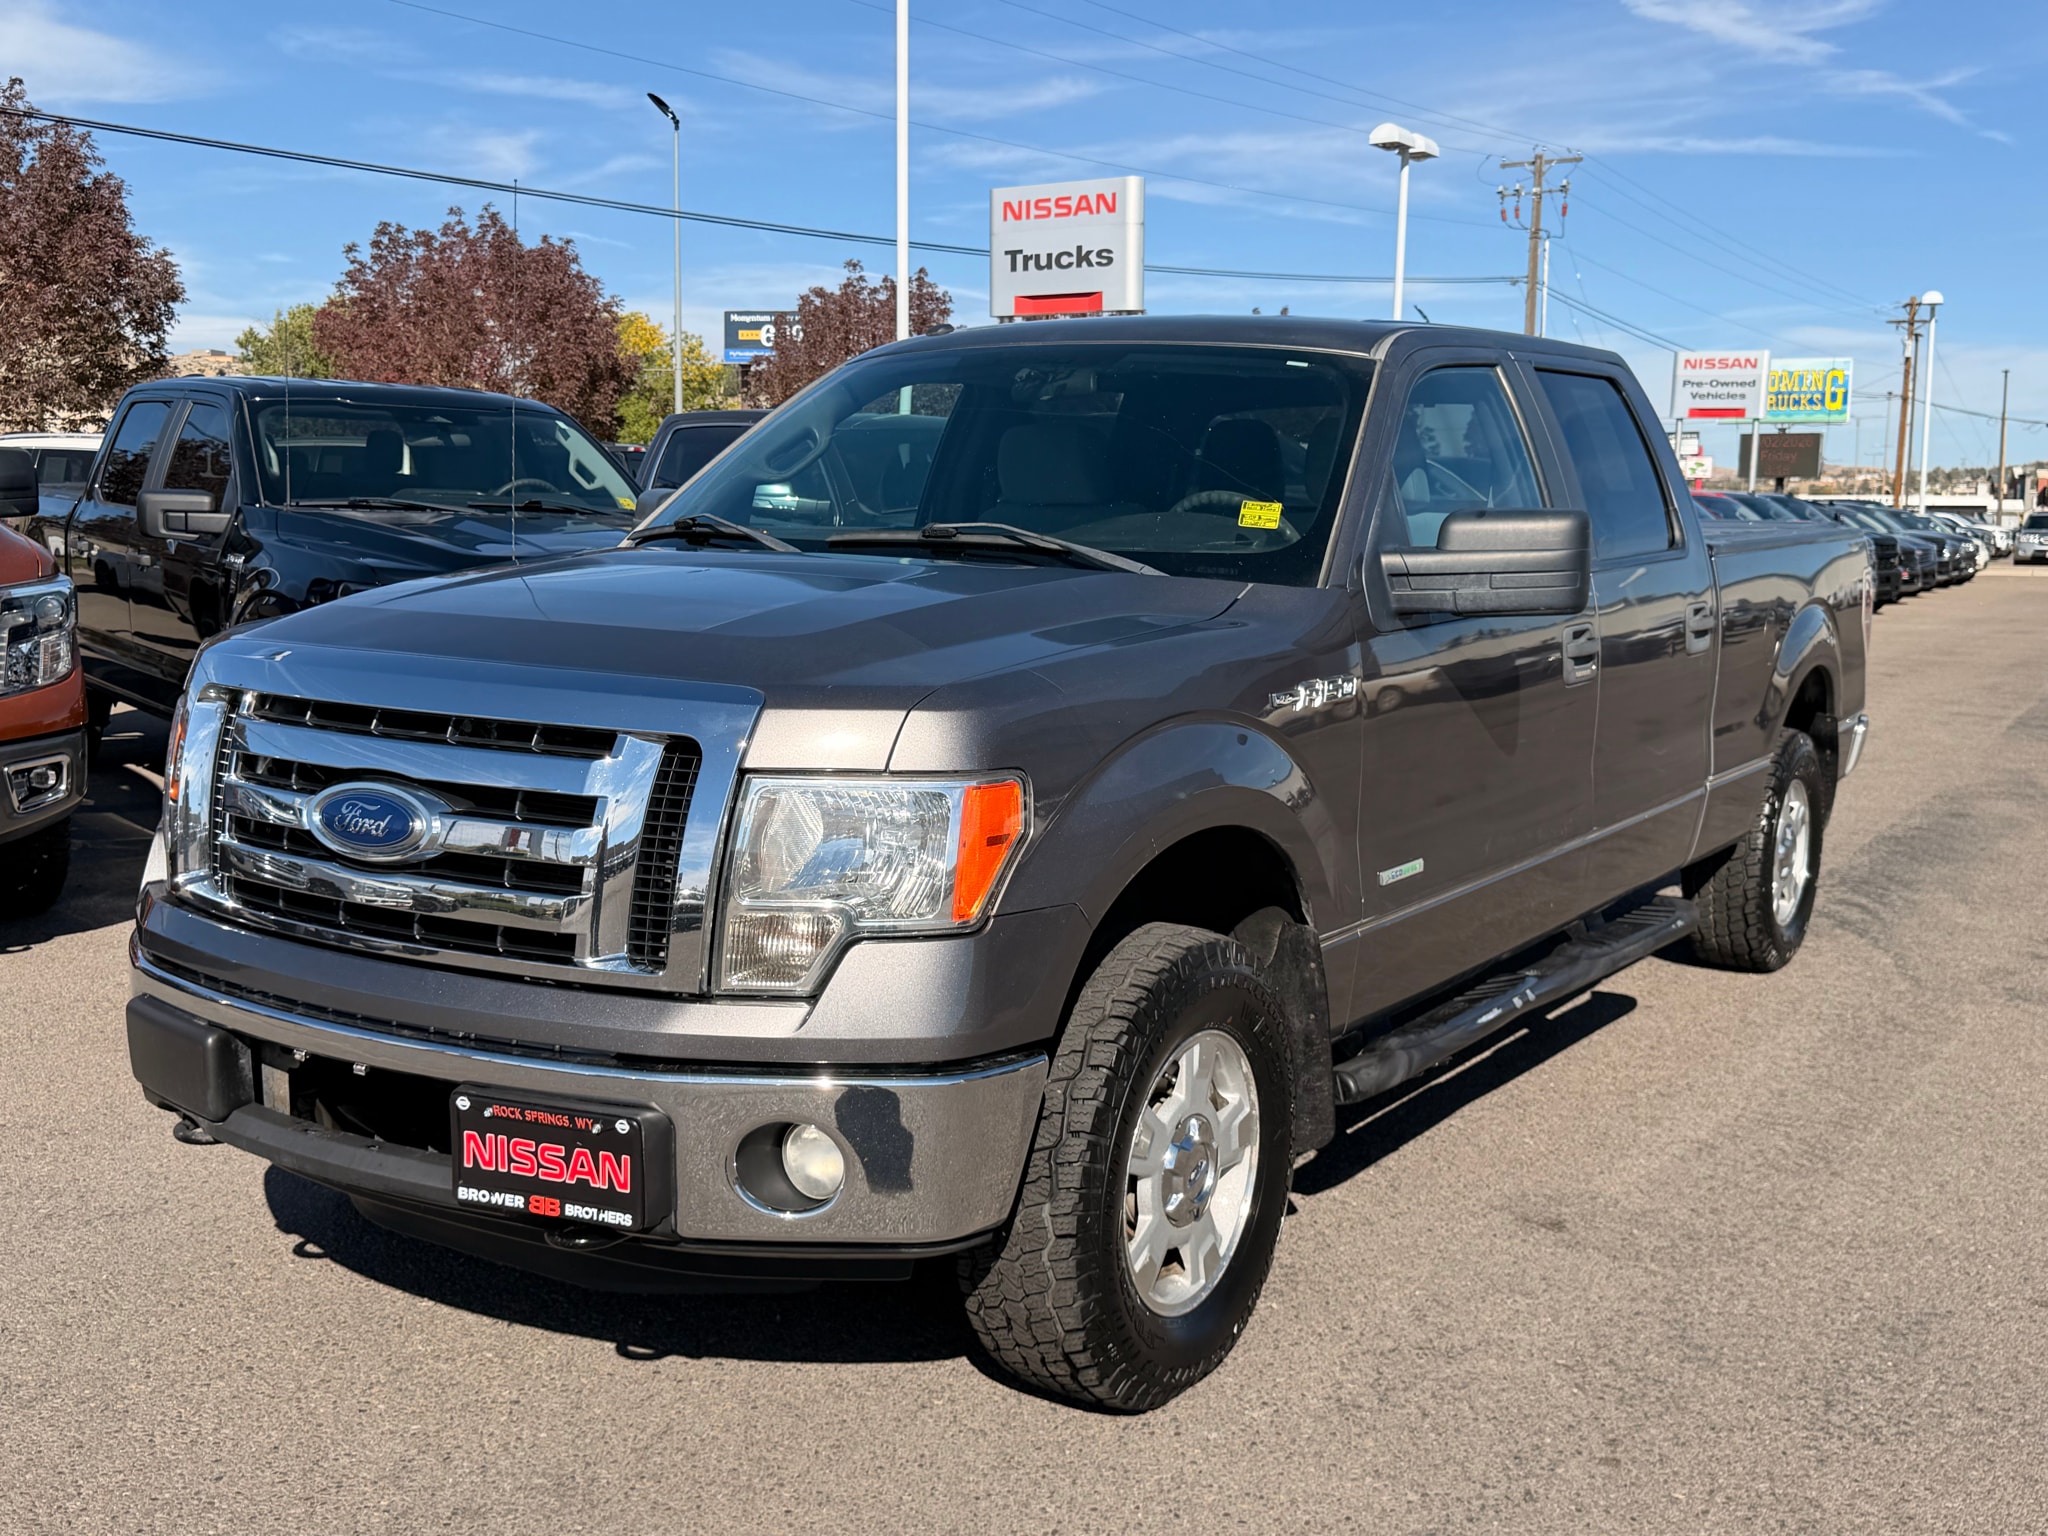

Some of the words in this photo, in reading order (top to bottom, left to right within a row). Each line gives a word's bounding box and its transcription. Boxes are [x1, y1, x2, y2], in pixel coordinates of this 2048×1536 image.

[1003, 192, 1117, 222] NISSAN
[1004, 245, 1114, 272] Trucks
[1683, 357, 1758, 370] NISSAN
[1682, 379, 1756, 388] Pre-Owned
[1690, 391, 1746, 401] Vehicles
[1767, 393, 1823, 411] RUCKS
[333, 800, 393, 837] Ford
[492, 1104, 523, 1121] ROCK
[574, 1116, 594, 1131] WY
[463, 1130, 631, 1194] NISSAN
[457, 1186, 525, 1209] BROWER
[564, 1203, 633, 1227] BROTHERS
